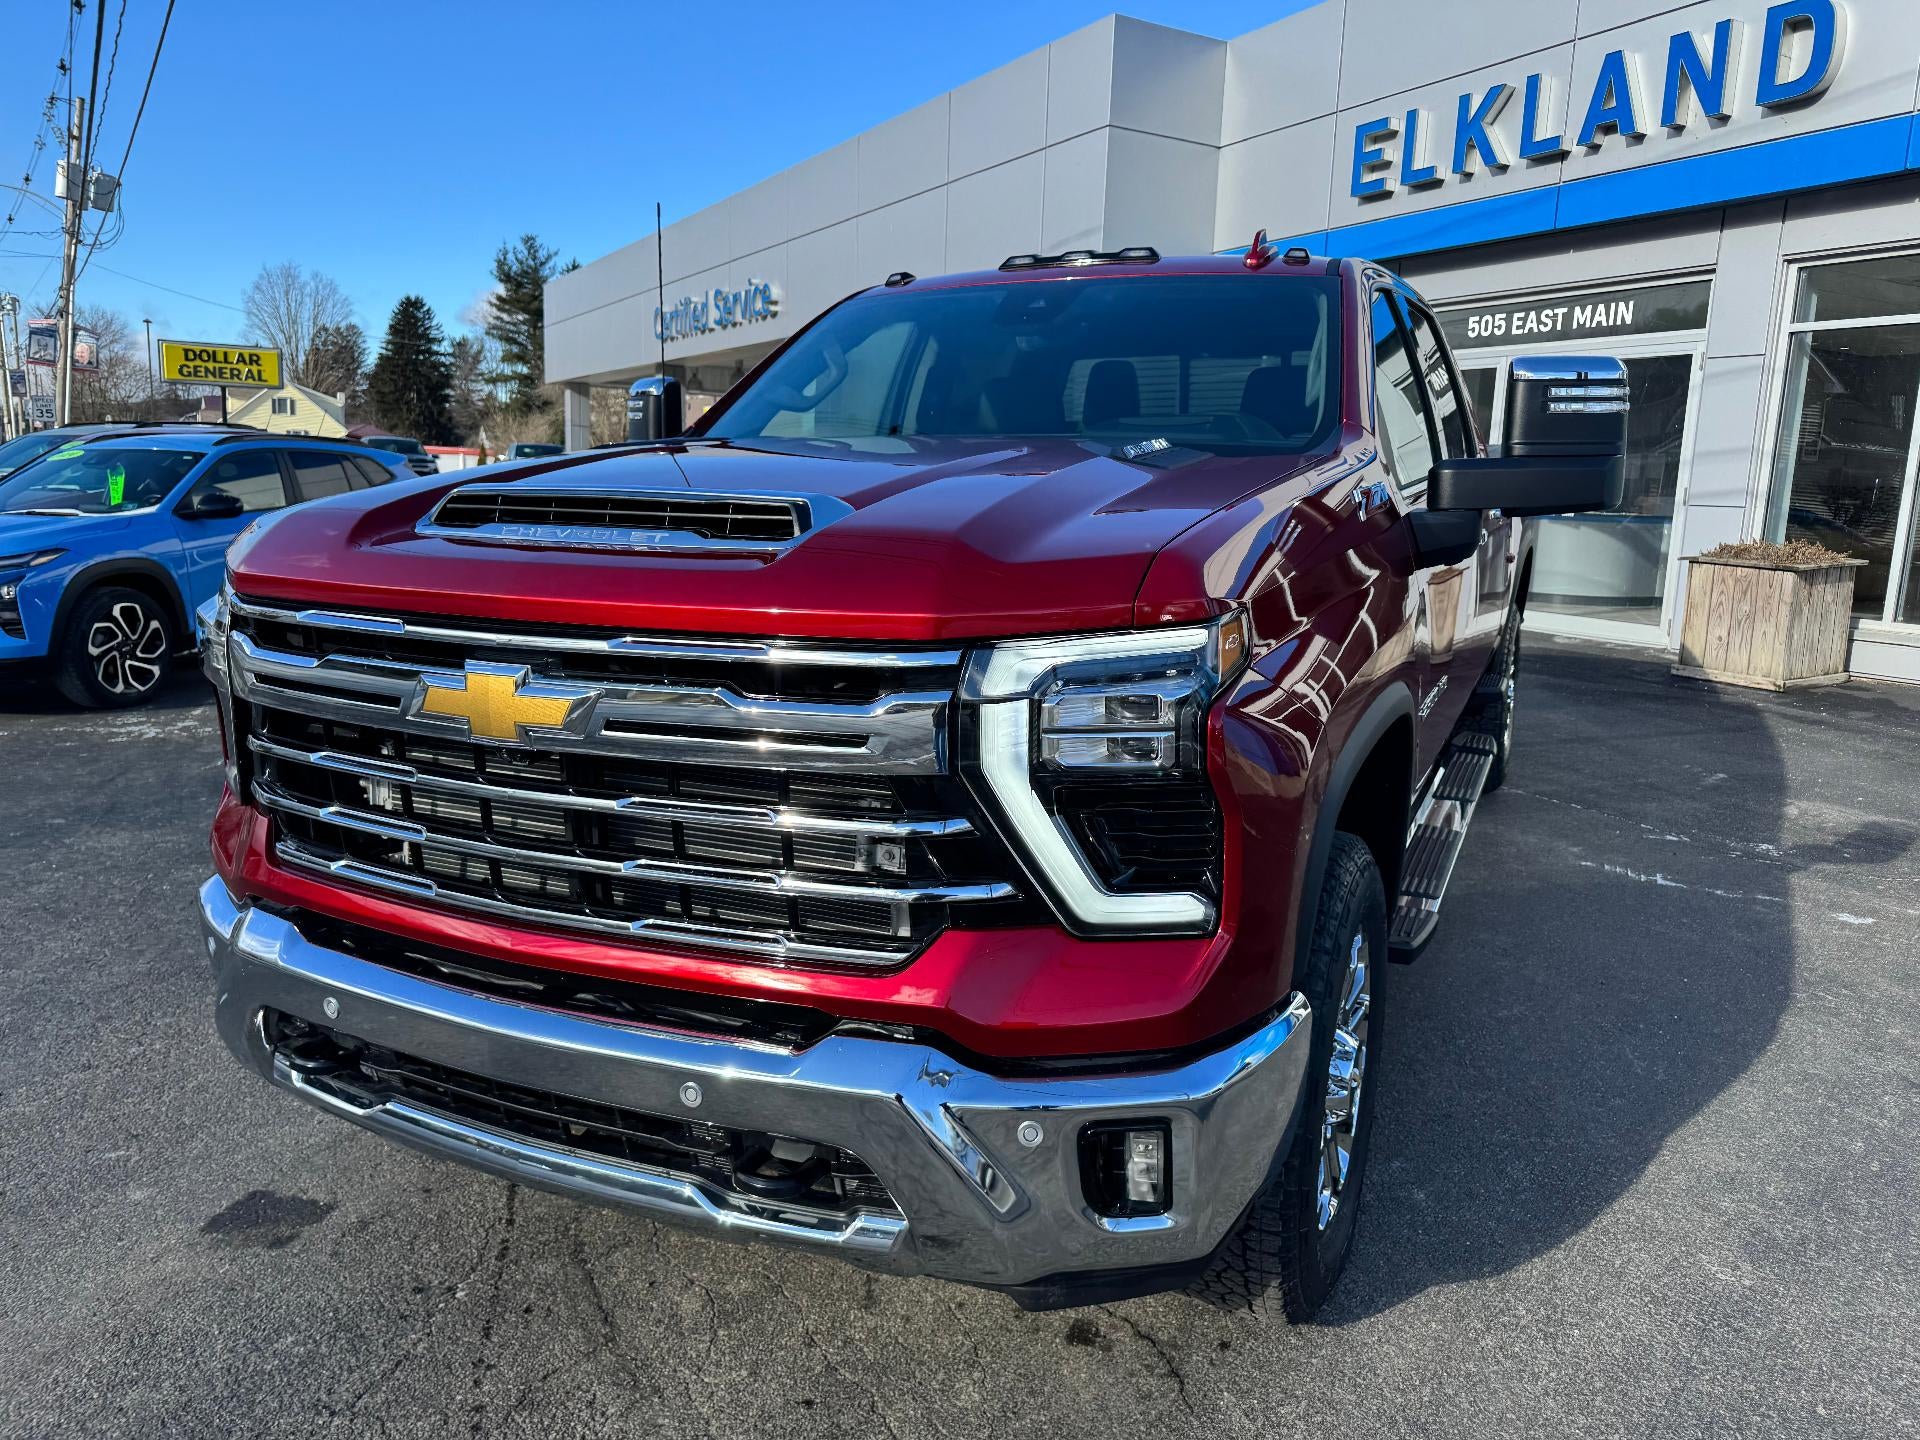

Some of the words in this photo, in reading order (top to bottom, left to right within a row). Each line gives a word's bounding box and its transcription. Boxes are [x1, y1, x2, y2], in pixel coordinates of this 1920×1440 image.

[1351, 0, 1840, 199] ELKLAND
[654, 289, 709, 340] Certified
[714, 278, 771, 326] Service
[1468, 313, 1506, 338] 505
[1511, 307, 1567, 335] EAST
[1572, 300, 1634, 329] MAIN
[182, 348, 262, 366] DOLLAR
[178, 364, 269, 383] GENERAL
[35, 408, 54, 419] 35
[502, 525, 670, 543] CHEVROLET
